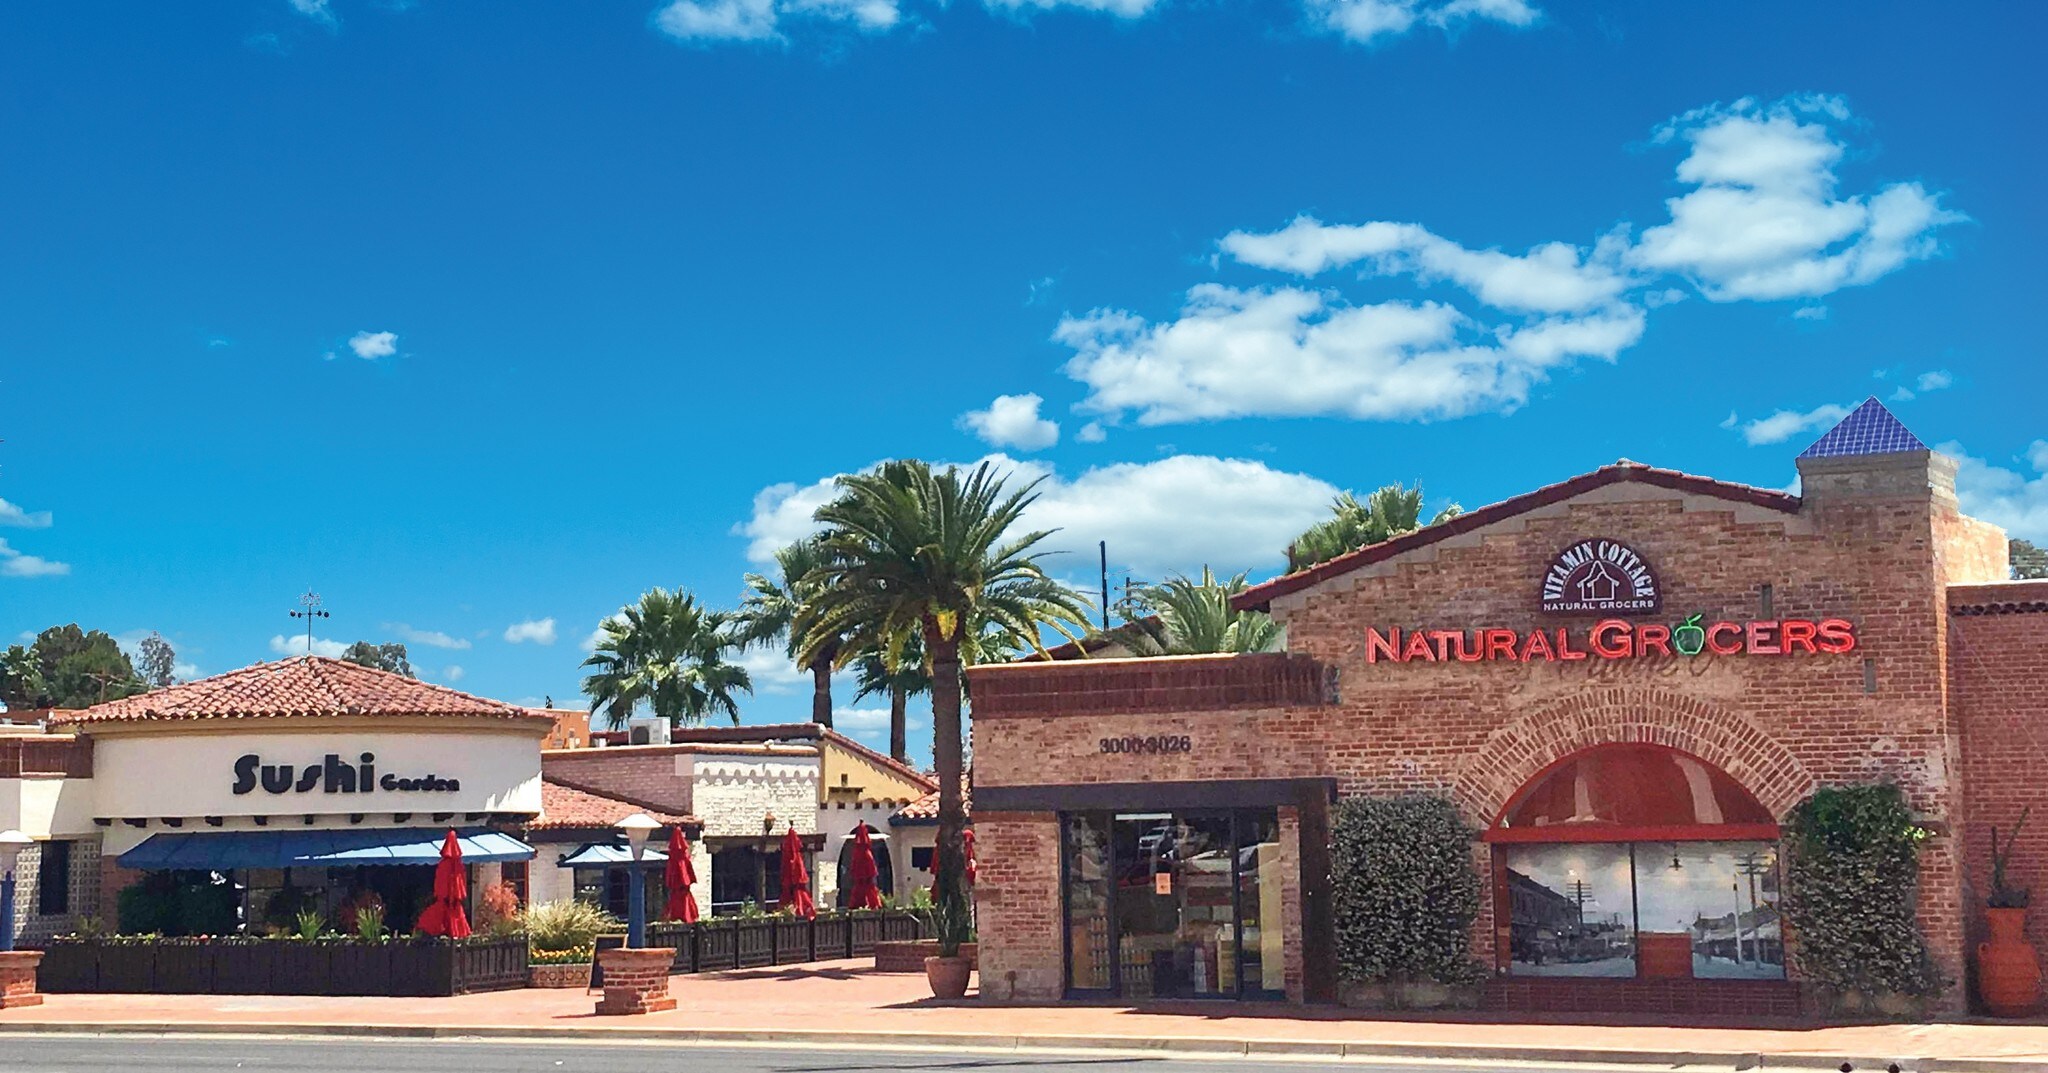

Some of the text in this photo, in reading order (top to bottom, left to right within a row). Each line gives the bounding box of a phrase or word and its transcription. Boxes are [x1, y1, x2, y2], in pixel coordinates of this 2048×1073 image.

[1543, 540, 1656, 600] VITAMIN COTTAGE
[1543, 600, 1655, 611] NATURAL GROCERS
[1364, 614, 1856, 664] NATURAL GROCERS
[232, 752, 461, 795] Sushi Garden
